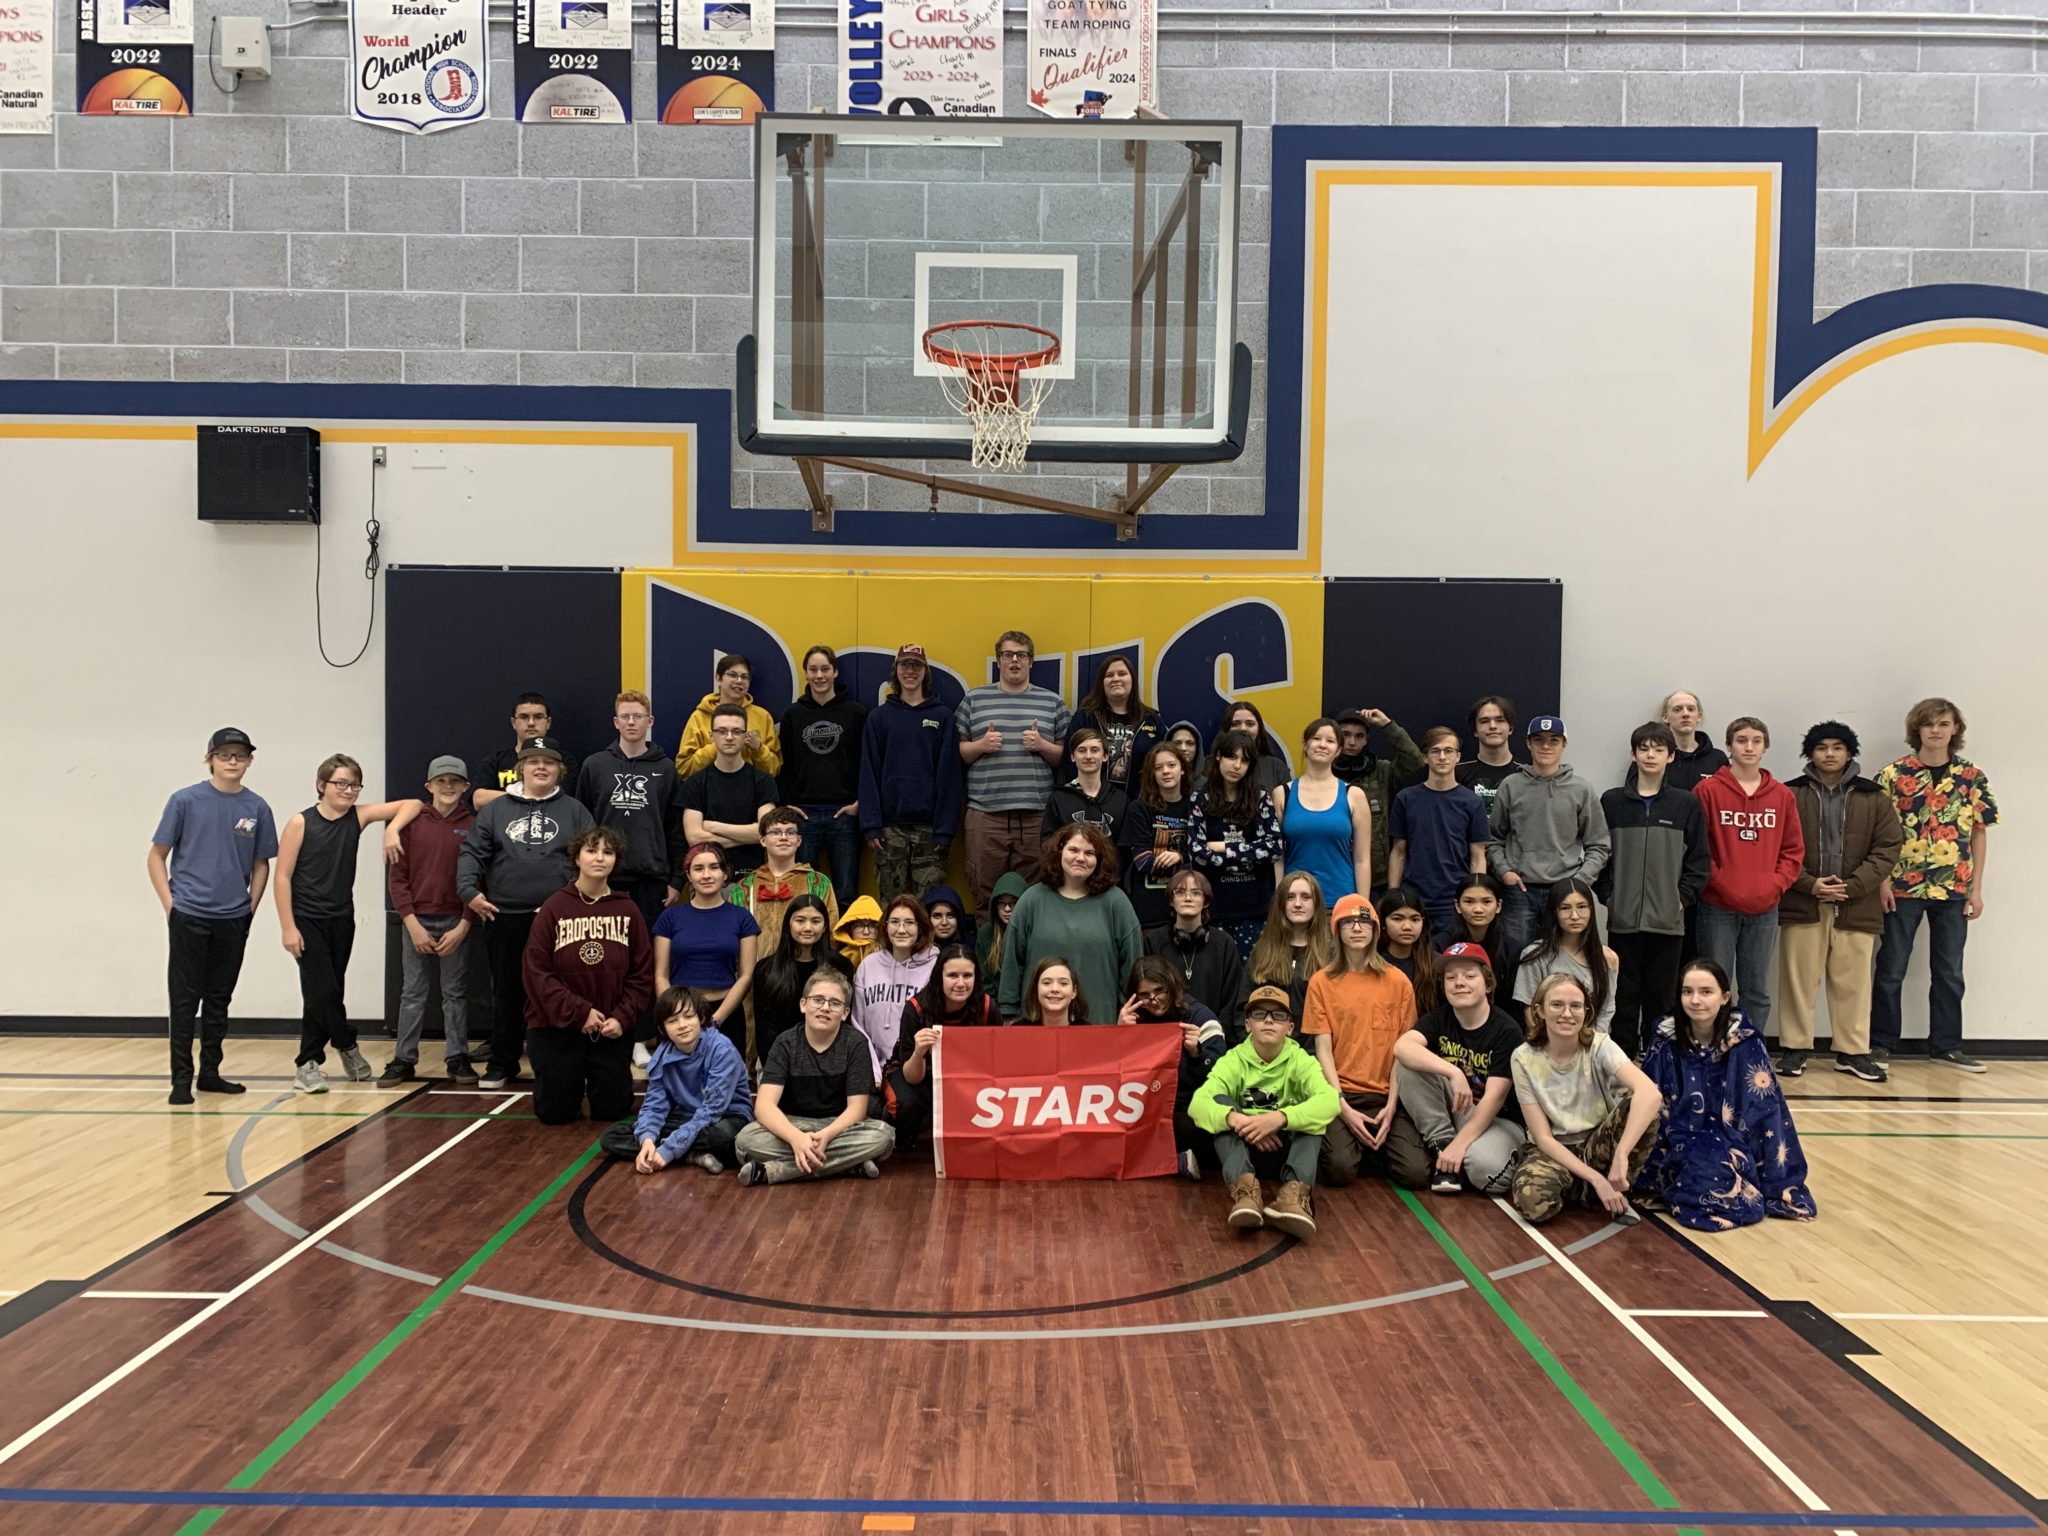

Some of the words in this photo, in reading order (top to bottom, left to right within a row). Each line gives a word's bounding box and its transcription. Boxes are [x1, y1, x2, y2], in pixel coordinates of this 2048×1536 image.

[391, 4, 447, 15] Header
[1048, 1, 1084, 10] GOAT
[1089, 1, 1127, 10] TYING
[915, 4, 970, 23] GIRLS
[1044, 19, 1080, 29] TEAM
[1083, 19, 1131, 30] ROPING
[363, 35, 410, 47] World
[888, 29, 996, 51] CHAMPIONS
[111, 48, 161, 64] 2022
[1039, 48, 1077, 58] FINALS
[362, 29, 467, 91] Champion
[549, 53, 598, 69] 2022
[691, 55, 741, 71] 2024
[1043, 45, 1128, 90] Qualifier
[946, 71, 980, 82] 2024
[1109, 73, 1136, 84] 2024
[2, 100, 38, 109] Natural
[377, 93, 422, 105] 2018
[943, 102, 996, 113] Canadian
[217, 426, 287, 434] DAKTRONICS
